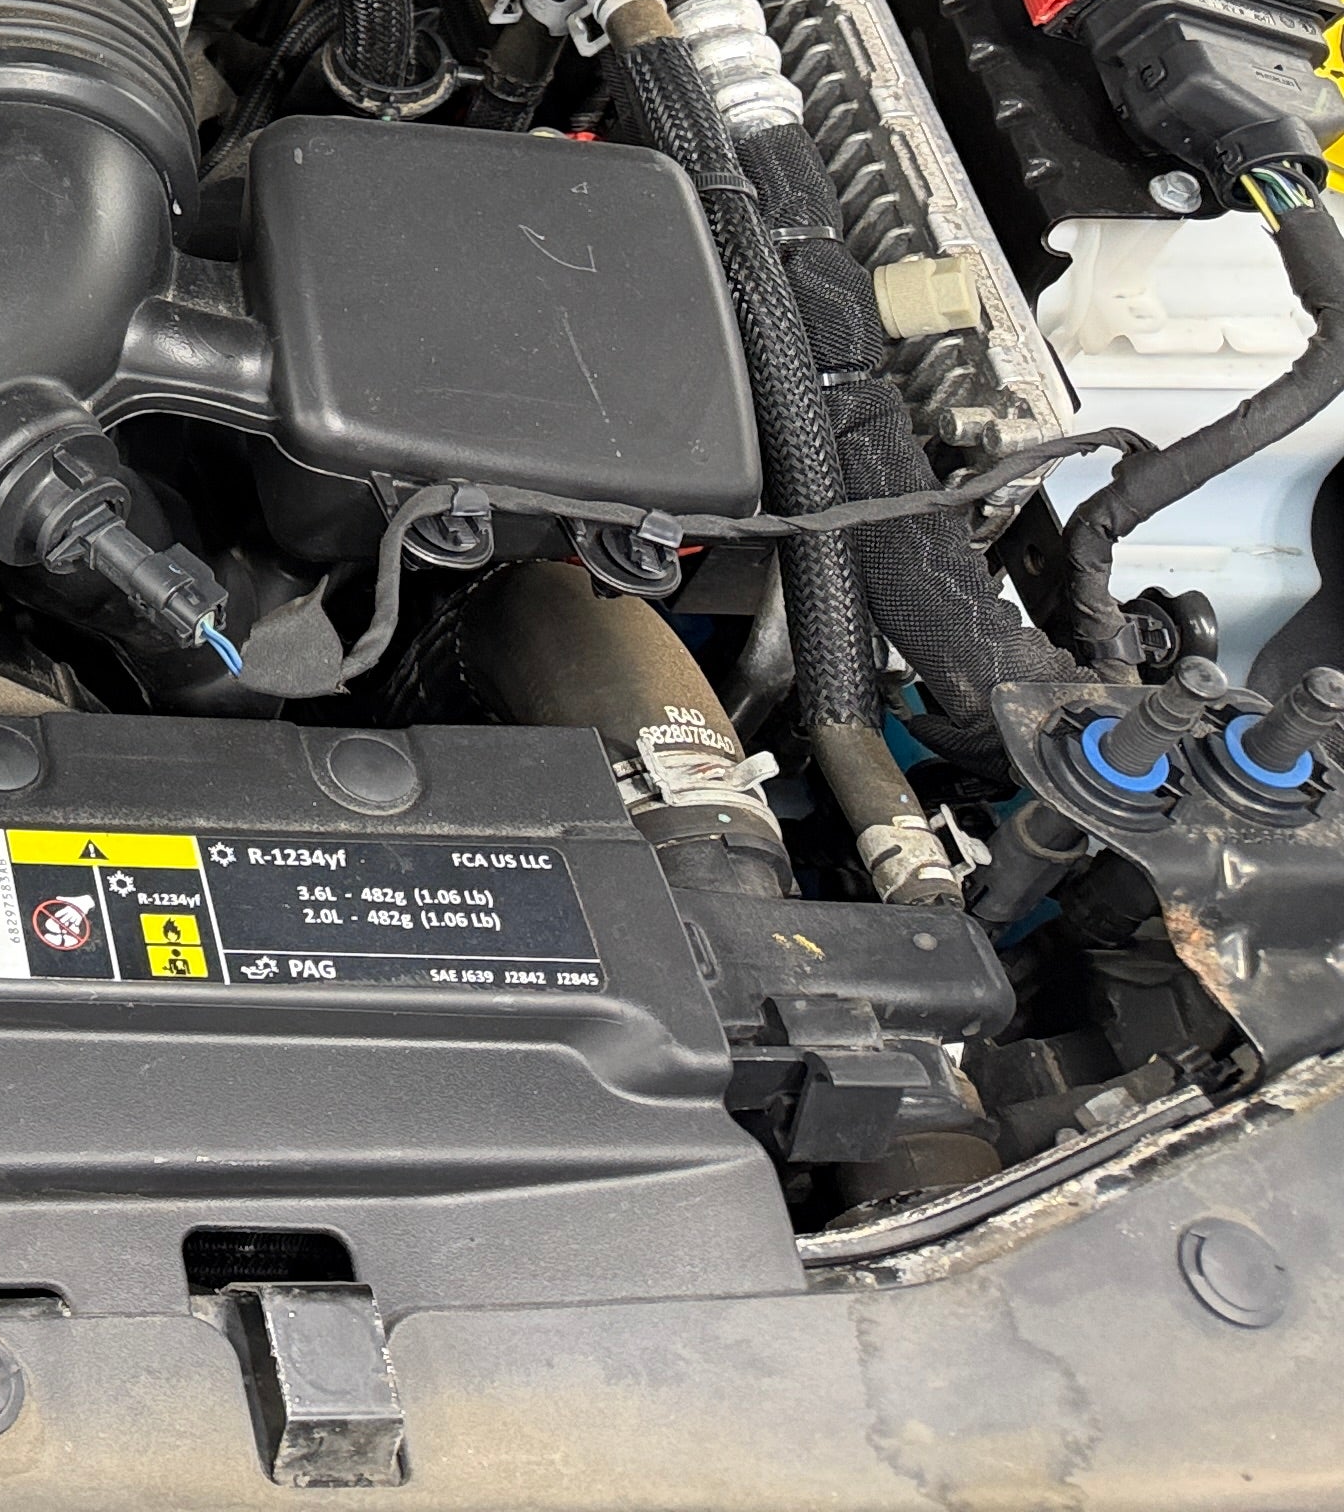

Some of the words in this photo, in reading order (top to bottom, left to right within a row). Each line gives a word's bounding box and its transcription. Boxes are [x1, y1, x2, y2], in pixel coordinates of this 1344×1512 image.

[664, 705, 706, 726] RAD
[247, 848, 347, 870] R-1234yf
[452, 853, 488, 868] FCA
[491, 854, 517, 869] US
[519, 855, 553, 870] LLC
[137, 893, 201, 908] R-1234yf
[297, 886, 337, 902] 3.6L
[361, 888, 407, 906] 482g
[414, 888, 462, 906] (1.06
[463, 889, 494, 908] Lb)
[303, 908, 343, 924] 2.0L
[367, 910, 413, 929] 482g
[421, 911, 469, 929] (1.06
[471, 912, 501, 931] Lb)
[288, 960, 337, 979] PAG
[429, 968, 459, 983] SAE
[462, 969, 494, 984] J639
[504, 970, 547, 985] J2842
[557, 972, 599, 987] J2845
